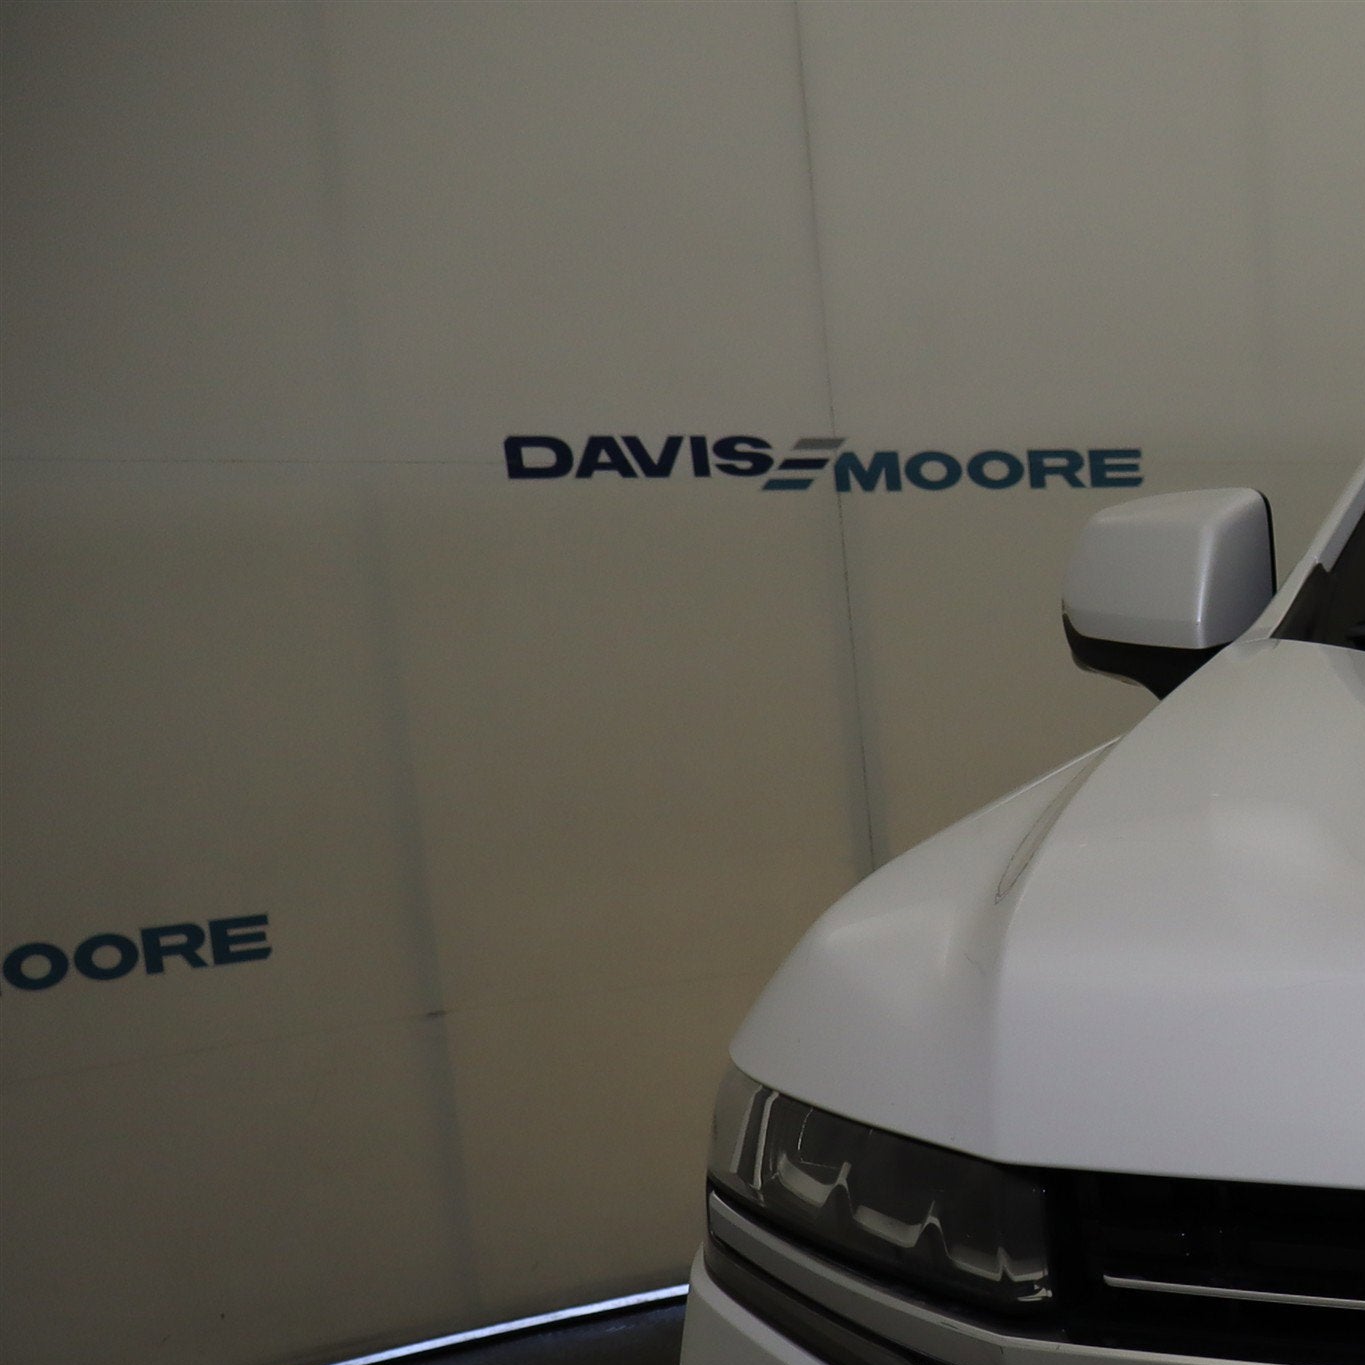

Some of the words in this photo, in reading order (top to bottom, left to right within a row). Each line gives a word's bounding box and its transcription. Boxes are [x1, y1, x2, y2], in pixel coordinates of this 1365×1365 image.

[503, 435, 775, 480] DAVIS
[832, 447, 1143, 493] MOORE
[0, 913, 273, 991] OORE
